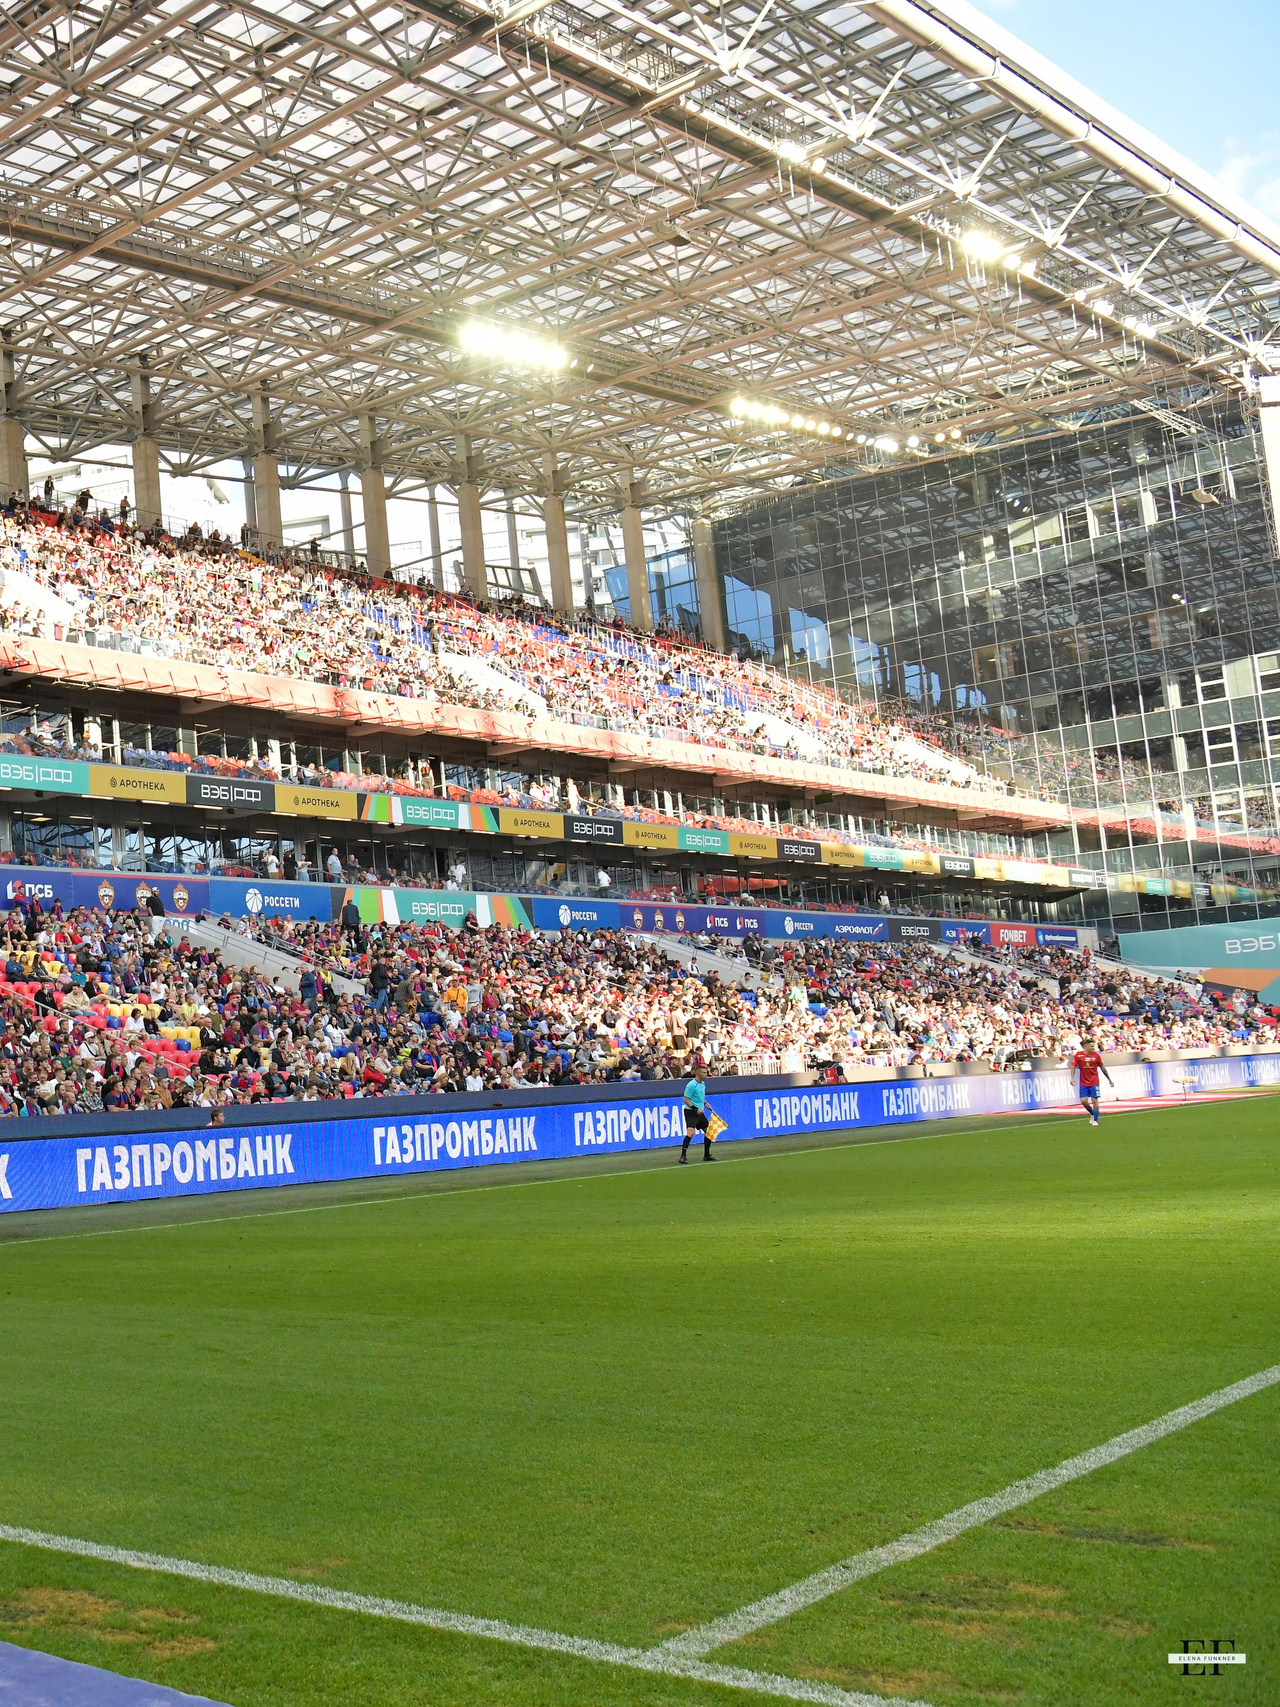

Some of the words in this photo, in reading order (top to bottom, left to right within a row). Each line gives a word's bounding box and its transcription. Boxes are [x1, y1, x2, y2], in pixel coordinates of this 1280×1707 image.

[119, 776, 166, 790] APOTHEKA
[301, 796, 340, 808] APOTHEKA
[519, 819, 551, 829] APOTHEKA
[641, 832, 667, 841] APOTHEKA
[744, 841, 767, 850] APOTHEKA
[25, 884, 54, 900] ПСБ
[264, 895, 300, 908] РОССЕТИ
[571, 911, 598, 921] РОССЕТИ
[714, 917, 729, 927] ПСБ
[744, 918, 758, 928] ПСБ
[794, 922, 814, 931] РОССЕТИ
[834, 924, 873, 935] АЭРОФЛОТ
[1000, 929, 1027, 943] FONBET
[1002, 1075, 1076, 1105] ГАЗПРОМБАНК
[882, 1083, 971, 1118] ГАЗПРОМБАНК
[754, 1091, 860, 1130] ГАЗПРОМБАНК
[573, 1104, 705, 1147] ГАЗПРОМБА
[373, 1116, 538, 1166] ГАЗПРОМБАНК
[76, 1133, 295, 1192] ГАЗПРОМБАНК
